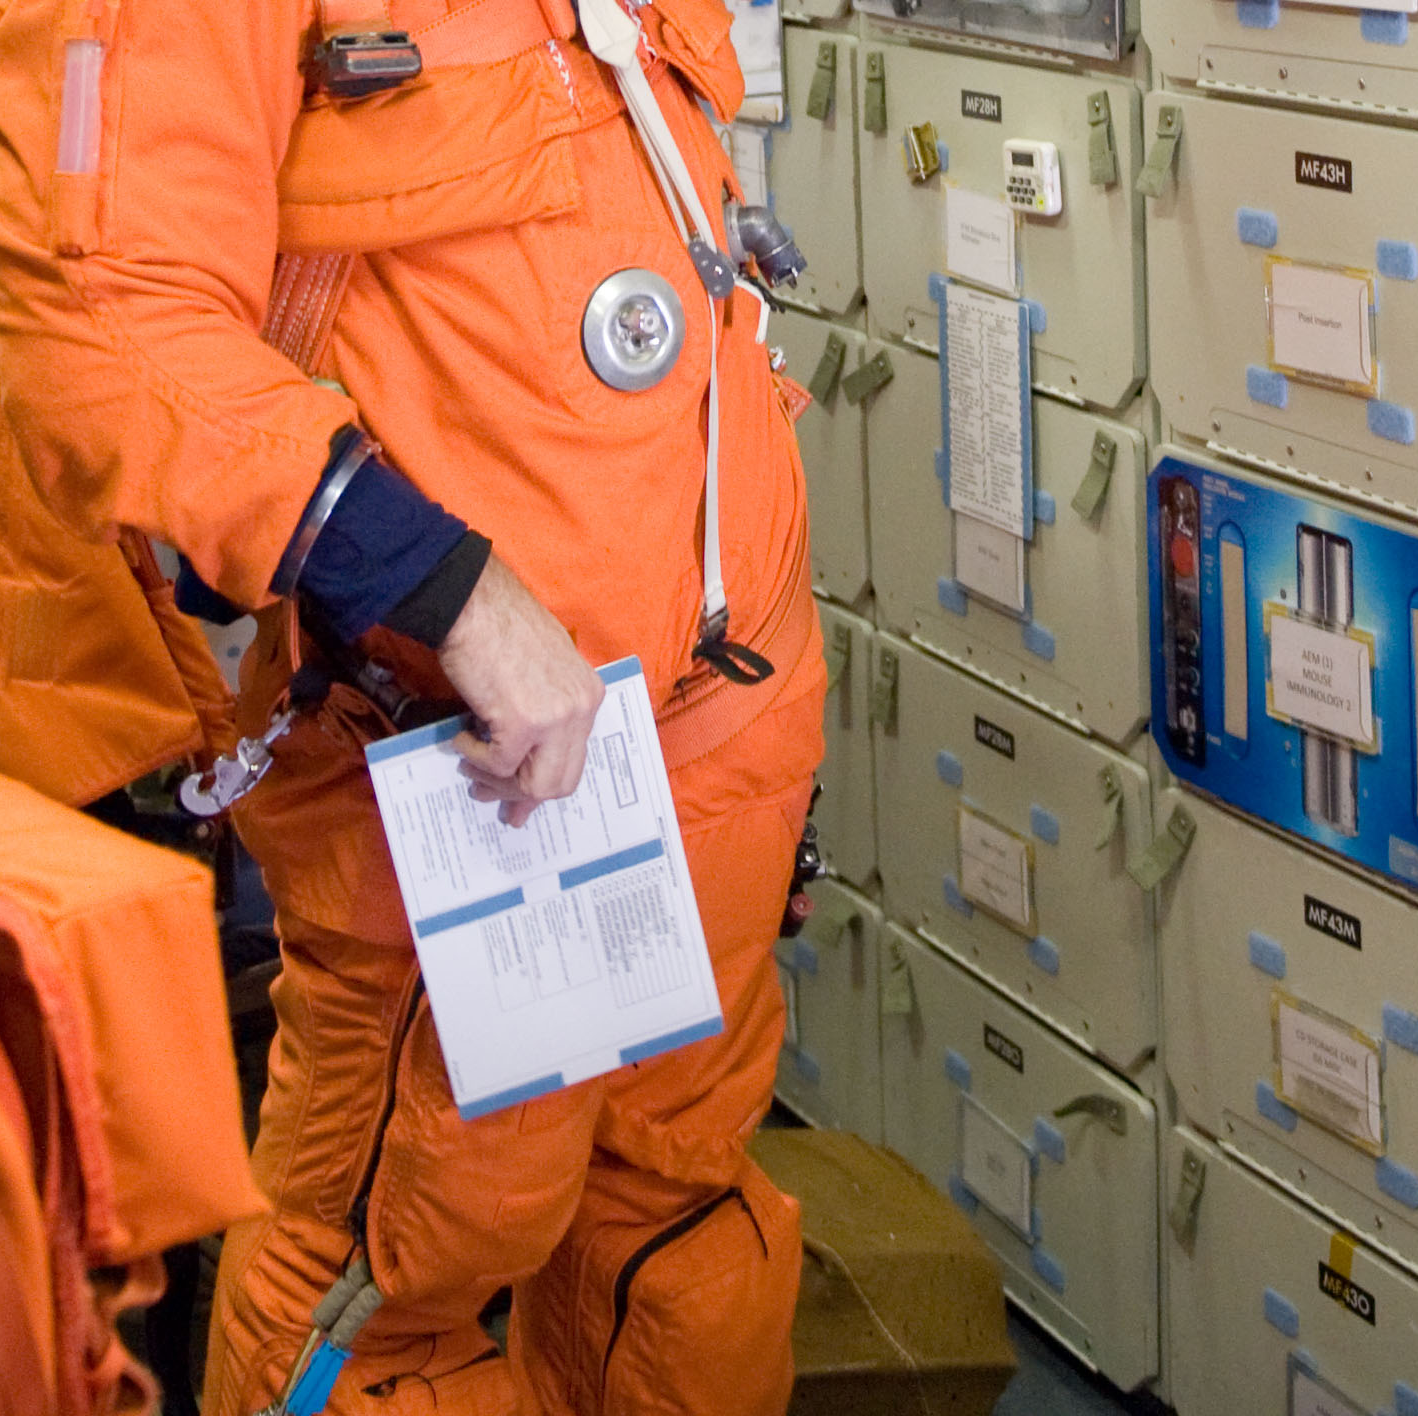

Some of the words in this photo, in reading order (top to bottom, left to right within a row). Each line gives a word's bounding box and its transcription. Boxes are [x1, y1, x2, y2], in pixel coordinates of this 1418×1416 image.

[965, 97, 999, 116] MF28H
[1299, 159, 1346, 185] MF43H
[1301, 649, 1321, 666] AEM
[1302, 668, 1333, 689] MOUSE
[1286, 680, 1345, 708] IMMUNOLOGY
[1308, 905, 1357, 942] MF43M
